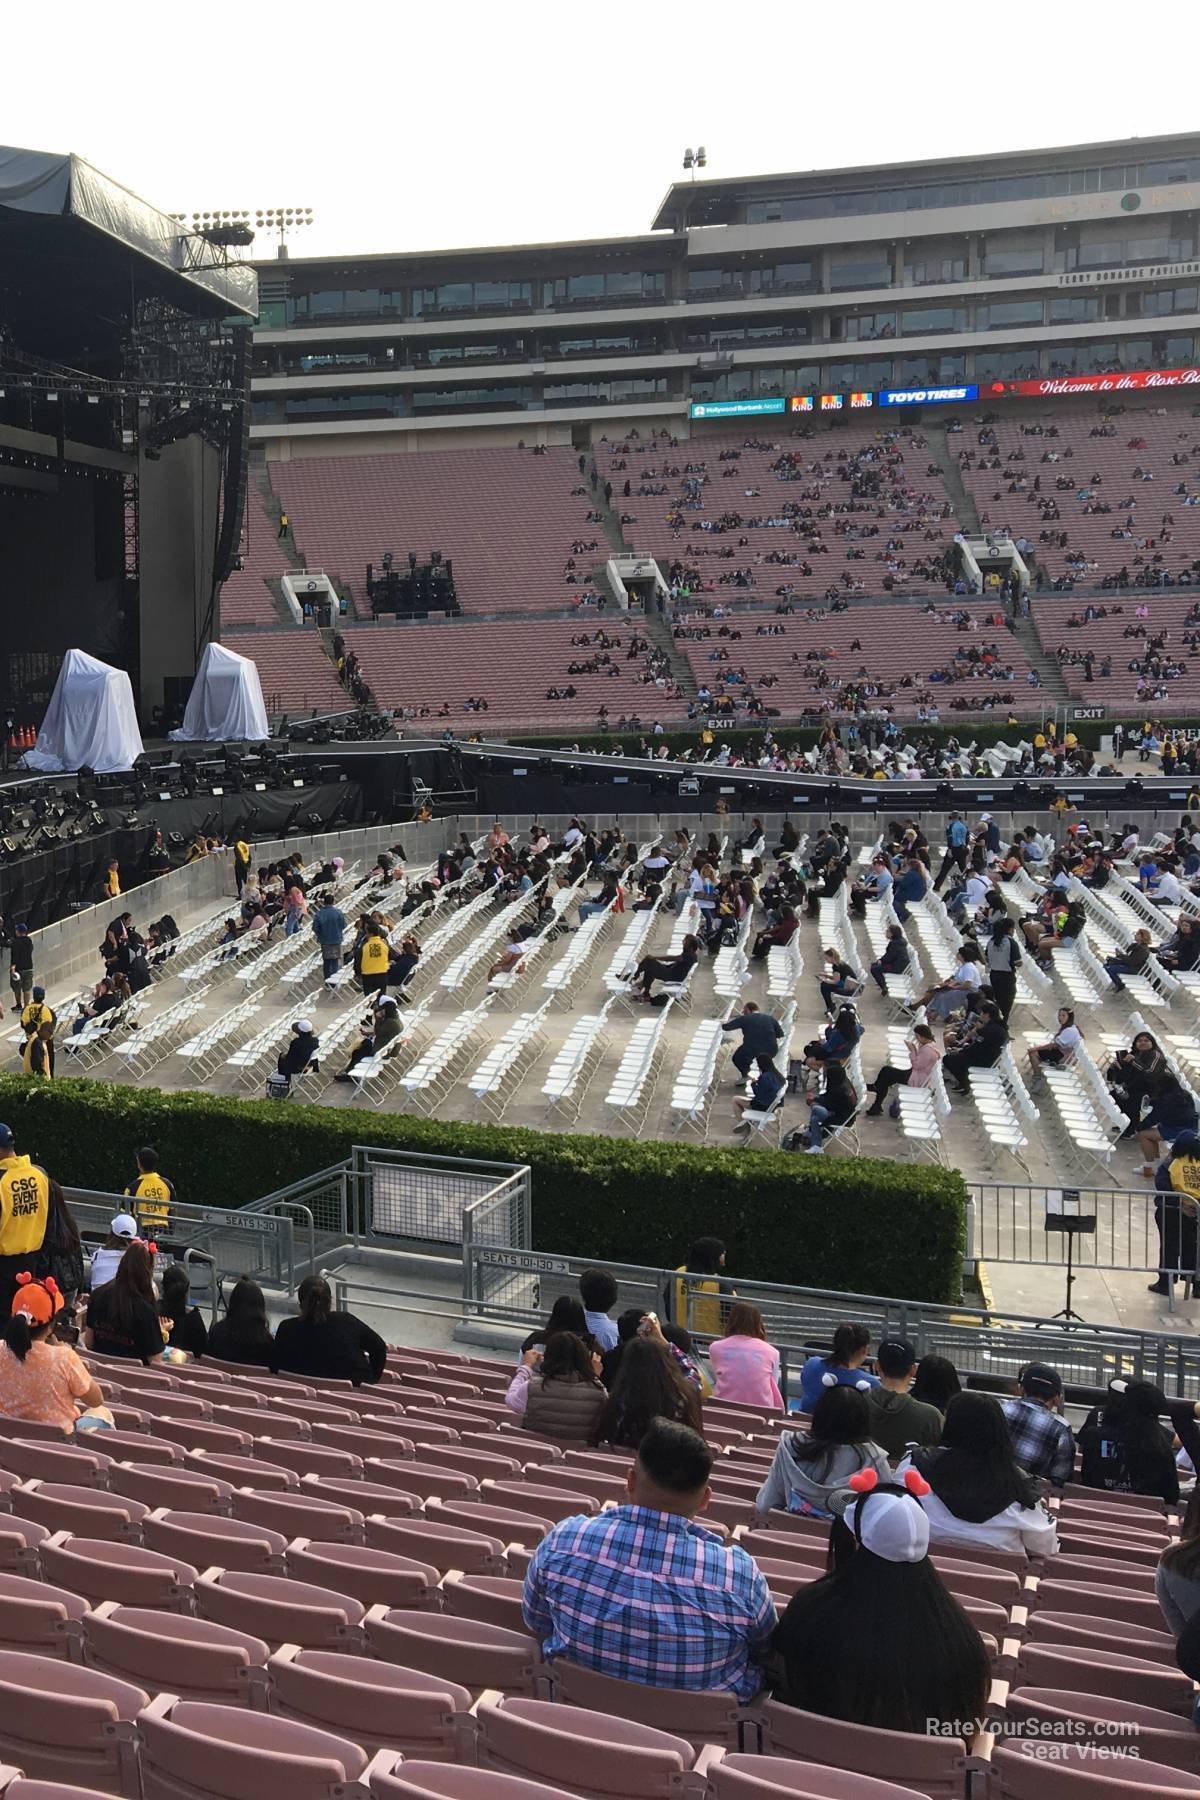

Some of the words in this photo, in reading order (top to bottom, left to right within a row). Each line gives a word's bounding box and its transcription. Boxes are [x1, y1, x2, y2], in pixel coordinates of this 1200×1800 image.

[1039, 380, 1098, 395] Welcome
[1099, 379, 1114, 391] to
[1115, 376, 1137, 390] the
[1141, 373, 1178, 388] Rose
[887, 392, 925, 403] TOYO
[923, 388, 967, 401] TIRES
[792, 403, 813, 412] KIND
[821, 402, 843, 410] KIND
[851, 399, 872, 408] KIND
[1073, 708, 1104, 719] EXIT
[707, 719, 735, 729] EXIT
[11, 1176, 37, 1192] CSC
[13, 1189, 38, 1206] EVENT
[144, 1187, 163, 1198] CSC
[12, 1202, 39, 1217] STAFF
[225, 1215, 255, 1229] SEATS
[255, 1219, 276, 1233] 1-30
[482, 1250, 518, 1266] SEATS
[520, 1254, 554, 1271] 101-130
